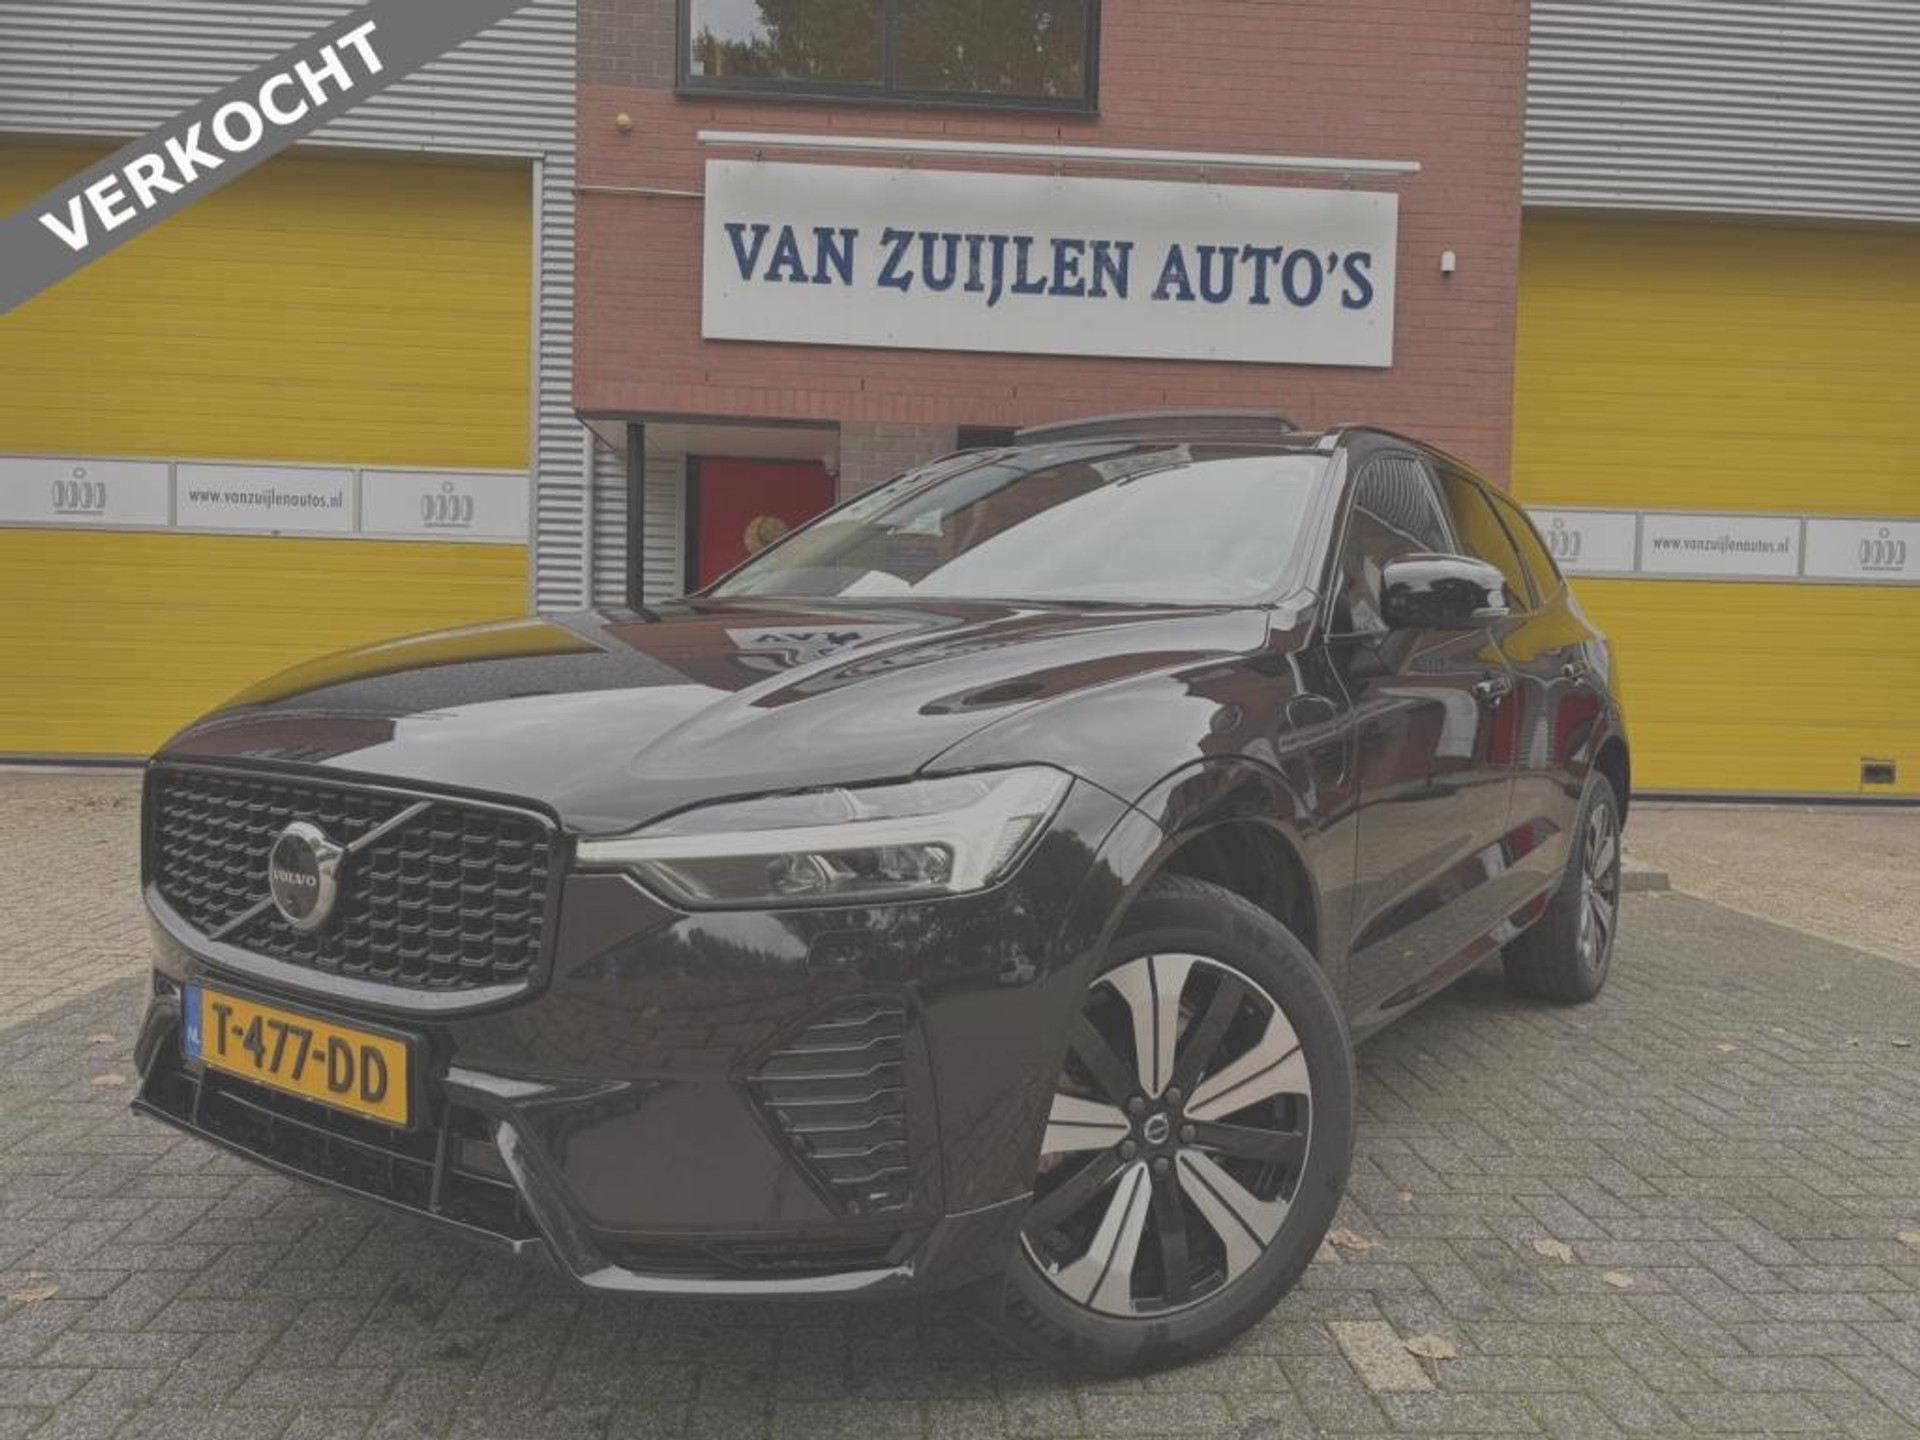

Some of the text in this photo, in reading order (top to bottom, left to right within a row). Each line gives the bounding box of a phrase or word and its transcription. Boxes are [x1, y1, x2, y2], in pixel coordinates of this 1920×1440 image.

[724, 222, 1374, 311] VAN ZUIJLEN AUTO'S
[189, 487, 343, 509] www.vanzuijlenautos.nl
[272, 870, 317, 887] VOLVO
[212, 1003, 388, 1103] T-477-DD
